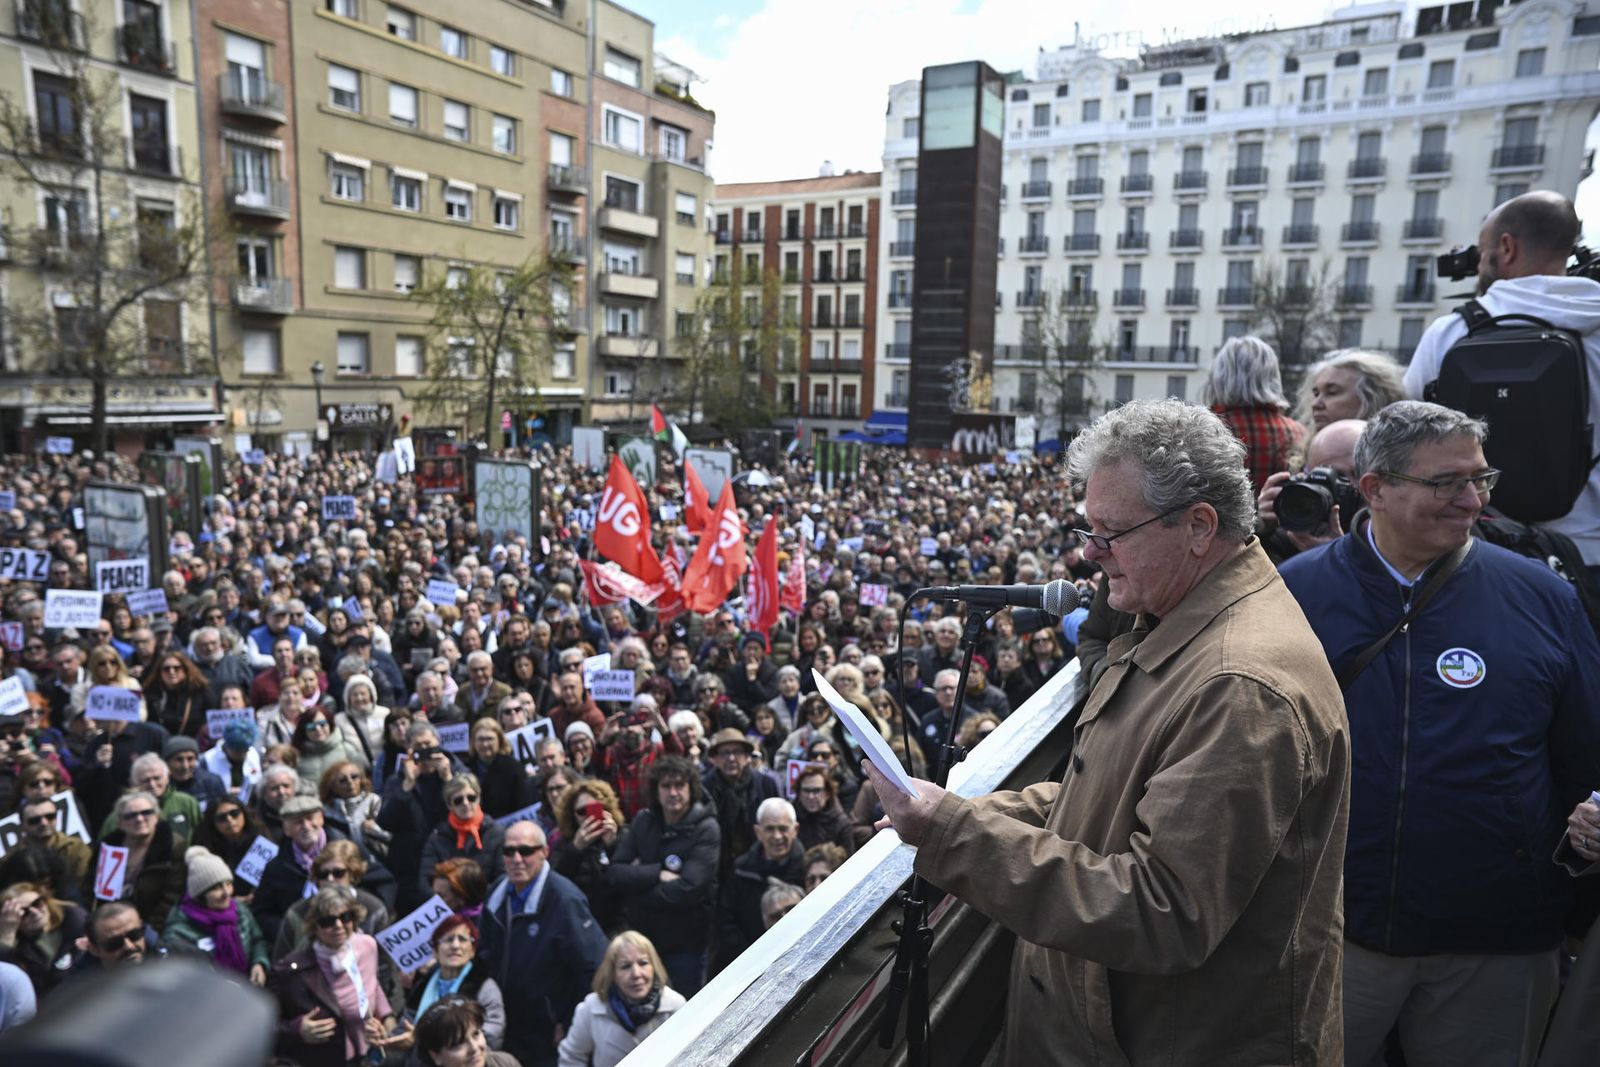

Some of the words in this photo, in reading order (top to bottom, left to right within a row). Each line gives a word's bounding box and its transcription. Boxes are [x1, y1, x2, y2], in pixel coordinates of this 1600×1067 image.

[1, 552, 47, 576] PAZ
[102, 565, 143, 590] PEACE!
[92, 693, 104, 710] NO
[413, 920, 427, 933] A
[424, 905, 448, 924] LA
[400, 939, 433, 968] GUE
